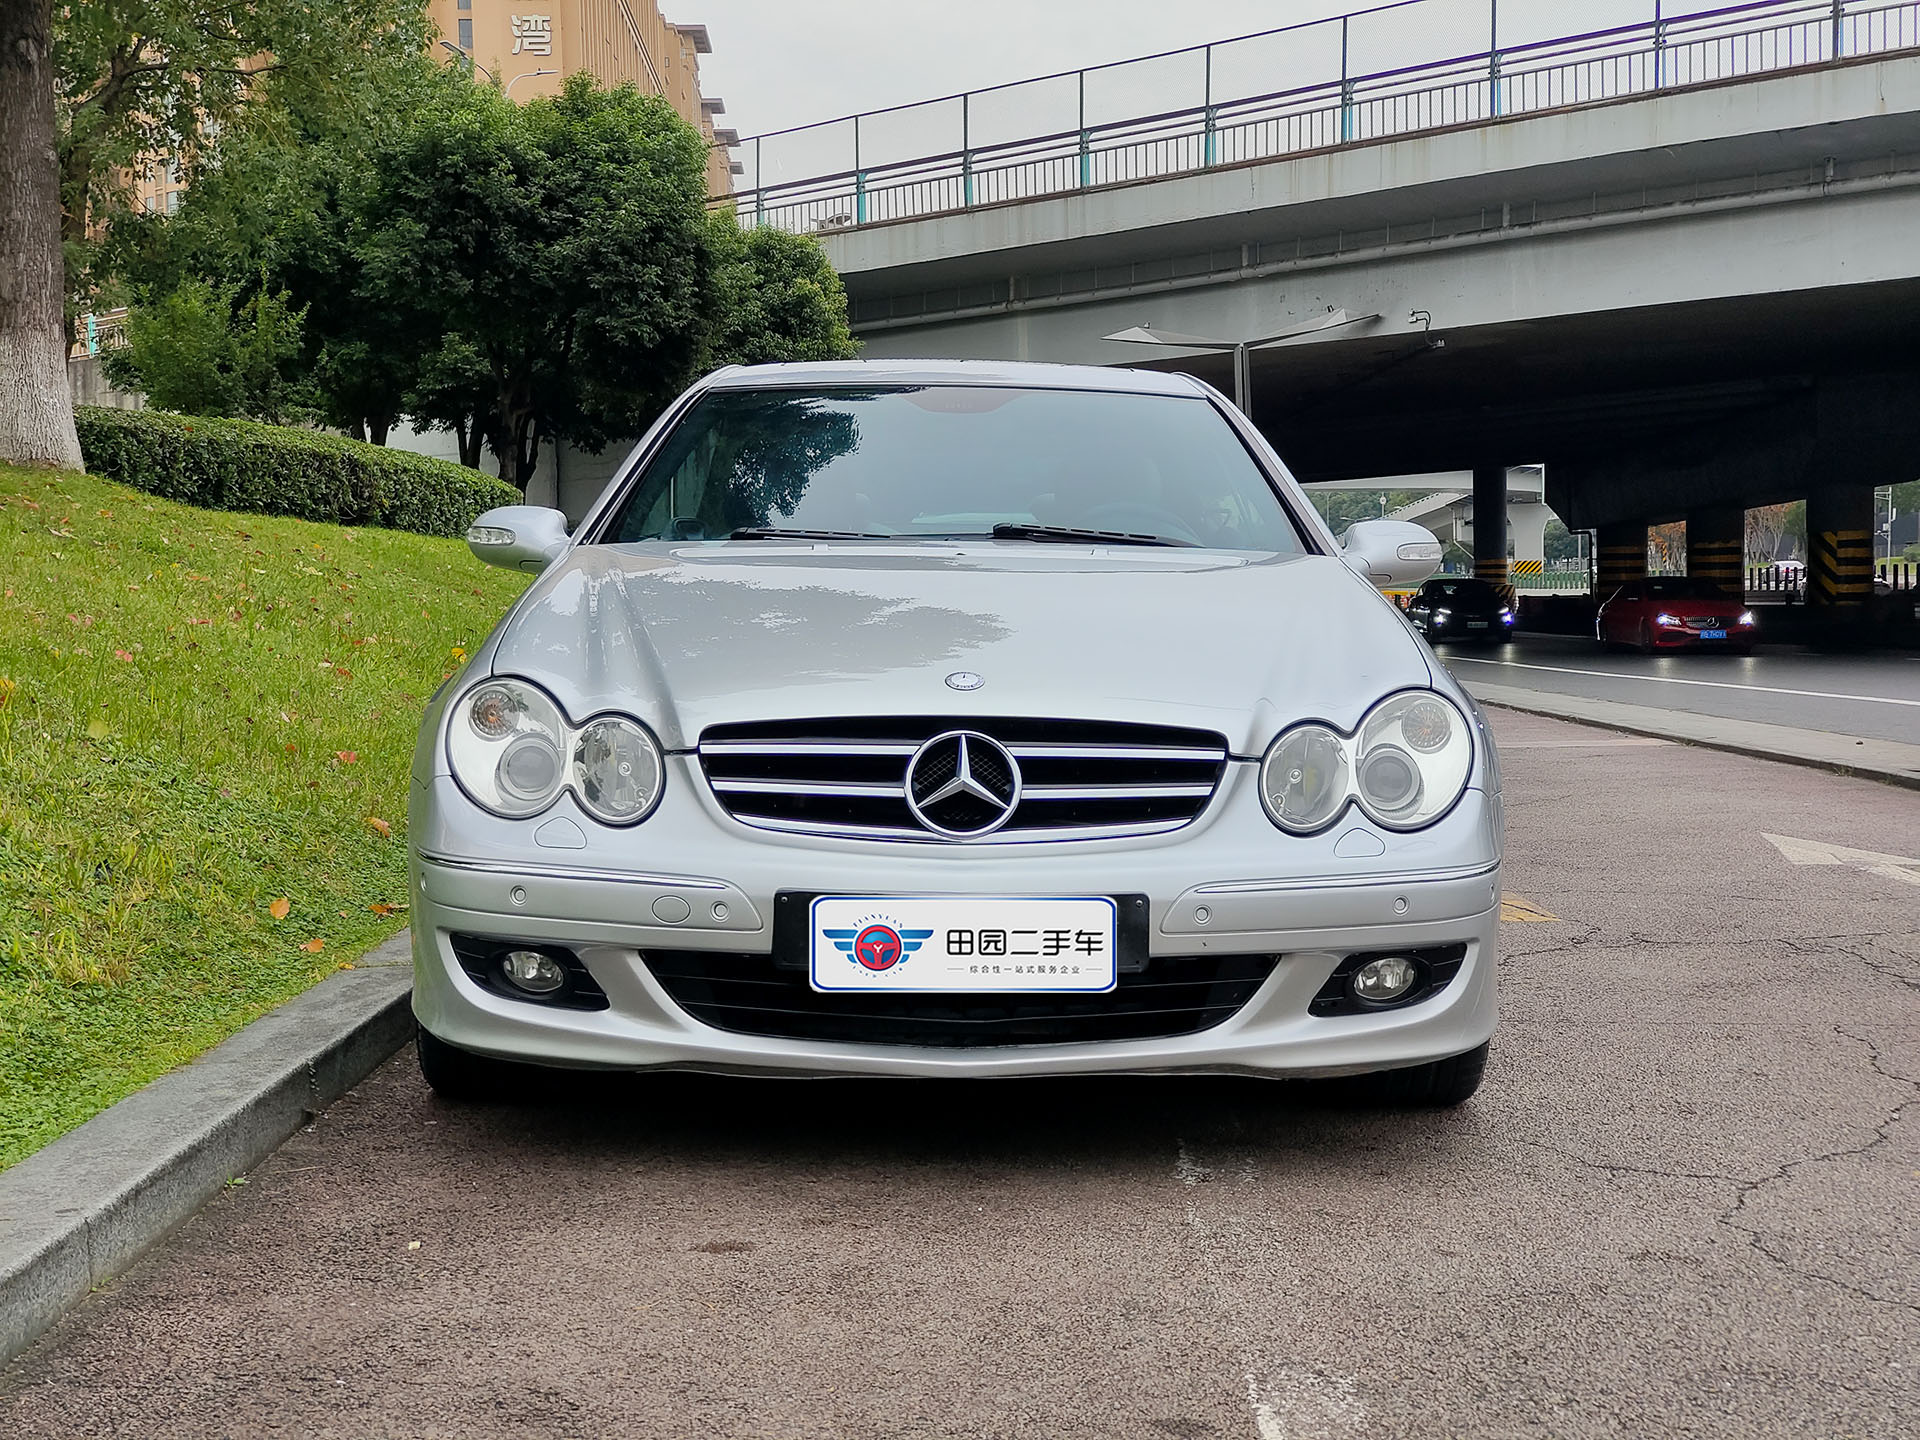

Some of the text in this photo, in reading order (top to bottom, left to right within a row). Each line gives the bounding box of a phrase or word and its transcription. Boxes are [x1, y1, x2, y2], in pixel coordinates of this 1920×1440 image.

[511, 14, 552, 56] 湾
[946, 928, 1104, 956] 田园二手车
[969, 965, 1080, 975] 综合性一站式服务企业
